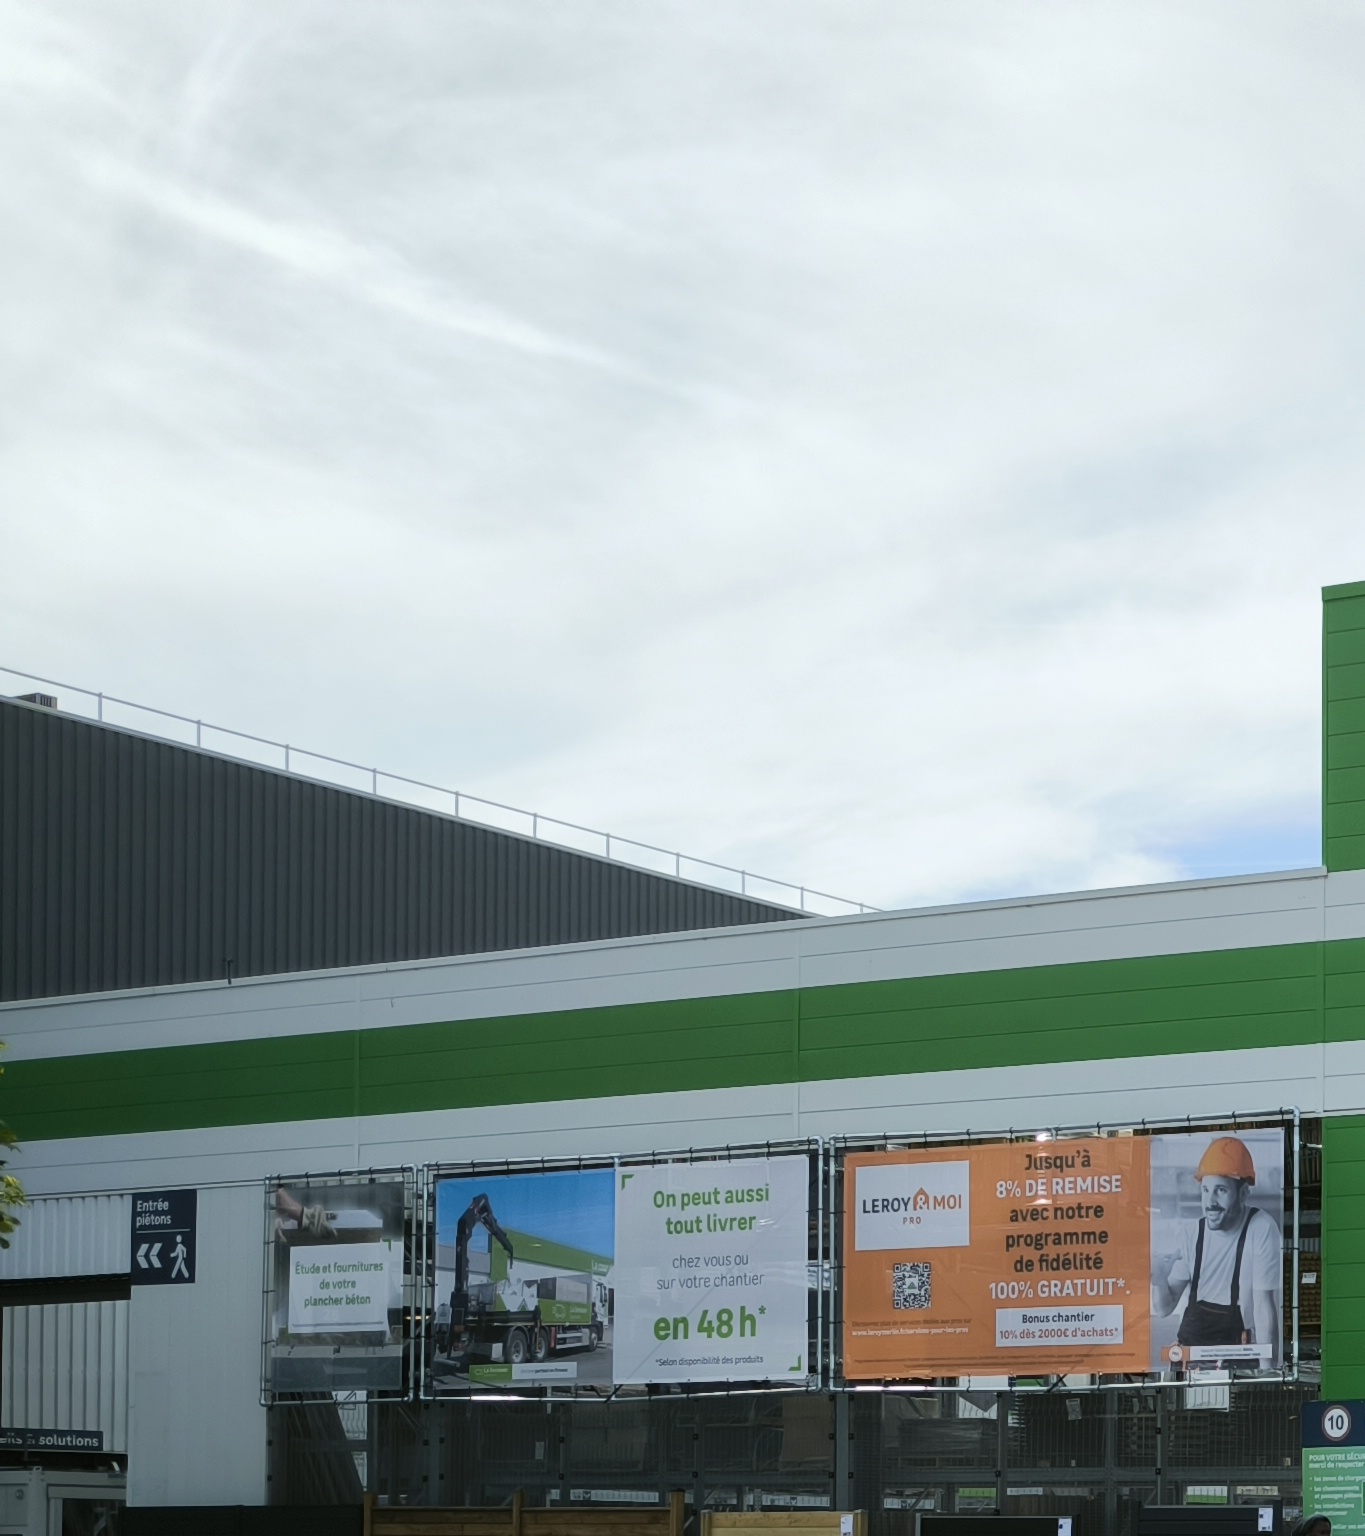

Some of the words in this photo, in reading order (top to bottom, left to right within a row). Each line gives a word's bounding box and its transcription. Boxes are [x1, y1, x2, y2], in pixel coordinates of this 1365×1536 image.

[1025, 1149, 1092, 1173] Jusqu'à
[996, 1180, 1022, 1198] 8%
[1025, 1178, 1047, 1197] DE
[1052, 1174, 1122, 1196] REMISE
[136, 1198, 169, 1212] Entrée
[653, 1190, 677, 1209] On
[681, 1187, 720, 1211] peut
[724, 1184, 770, 1204] aussi
[863, 1196, 912, 1214] LEROY
[933, 1194, 962, 1210] MOI
[136, 1213, 172, 1228] piétons
[902, 1216, 922, 1225] PRO
[1009, 1206, 1050, 1223] avec
[1053, 1202, 1105, 1220] notre
[666, 1216, 703, 1235] tout
[707, 1213, 757, 1233] livrer
[1005, 1230, 1109, 1252] programme
[295, 1261, 320, 1275] Étude
[322, 1264, 332, 1273] et
[334, 1261, 384, 1273] fournitures
[672, 1254, 700, 1269] chez
[703, 1254, 732, 1267] vous
[734, 1253, 749, 1266] ou
[1014, 1255, 1035, 1273] de
[1039, 1251, 1104, 1272] fidélité
[319, 1279, 330, 1290] de
[332, 1279, 357, 1289] votre
[657, 1277, 676, 1290] sur
[678, 1274, 711, 1289] votre
[713, 1272, 765, 1288] chantier
[989, 1281, 1034, 1300] 100%
[304, 1295, 344, 1308] plancher
[346, 1294, 371, 1305] béton
[653, 1315, 689, 1341] en
[697, 1308, 734, 1339] 48
[1022, 1313, 1051, 1325] Bonus
[1052, 1311, 1095, 1324] chantier
[999, 1328, 1018, 1340] 10%
[1019, 1327, 1036, 1340] dès
[1038, 1327, 1069, 1339] 2000€
[679, 1356, 720, 1367] disponibilité
[735, 1355, 764, 1365] produits
[1327, 1414, 1344, 1431] 10
[38, 1434, 99, 1447] solutions
